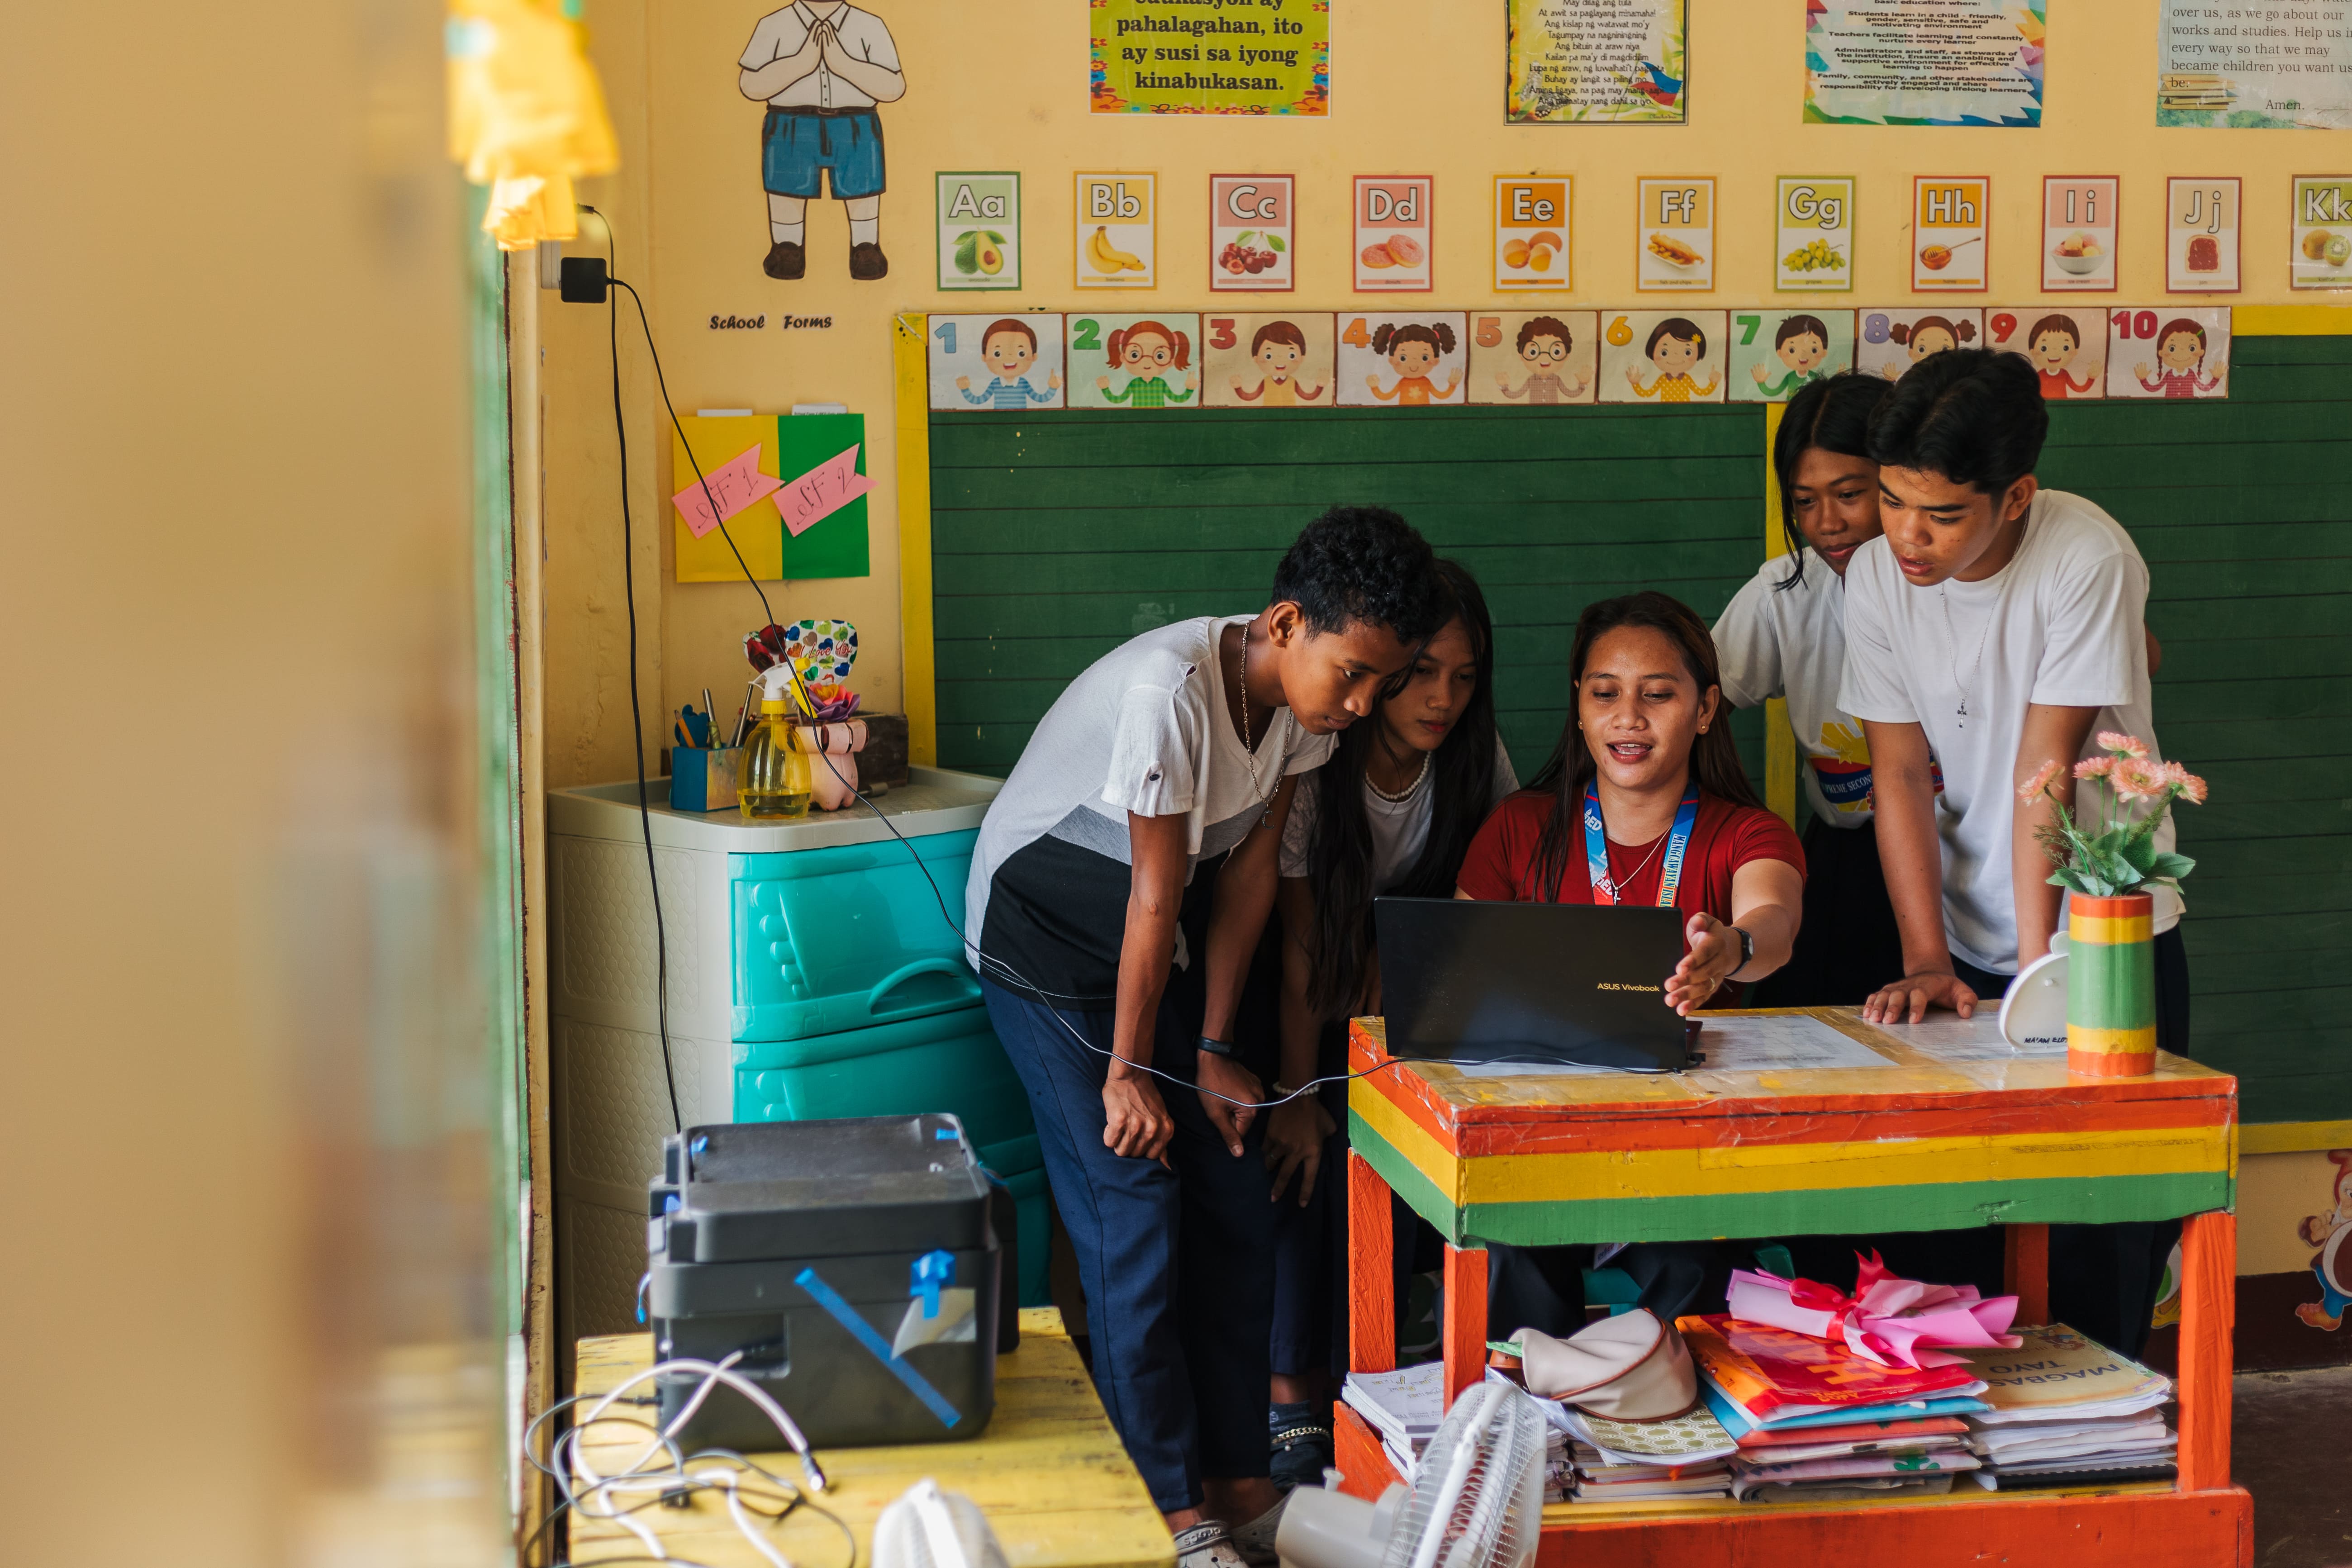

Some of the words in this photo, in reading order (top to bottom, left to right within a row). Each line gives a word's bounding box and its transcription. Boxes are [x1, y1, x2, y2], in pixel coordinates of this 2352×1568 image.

[1117, 15, 1265, 37] pahalagahan,
[1273, 18, 1303, 34] ito
[1544, 19, 1560, 29] Ang
[1563, 20, 1583, 30] kislap
[1586, 21, 1595, 29] ng
[1631, 19, 1649, 30] mo'y
[1579, 9, 1616, 19] paglayang
[2173, 9, 2200, 17] over
[2203, 10, 2222, 19] us,
[2266, 11, 2279, 21] go
[2284, 9, 2319, 19] about
[1547, 30, 1585, 41] Tagumpay
[1598, 31, 1647, 41] nagniningning
[2172, 25, 2209, 35] works
[2214, 25, 2237, 35] and
[2242, 26, 2289, 36] studies.
[2295, 27, 2322, 39] Help
[1122, 48, 1148, 65] ay
[1155, 44, 1200, 61] susi
[1207, 49, 1231, 61] sa
[1239, 44, 1298, 67] iyong
[1555, 42, 1570, 52] Ang
[1625, 43, 1639, 52] niya
[1580, 52, 1598, 63] ma'y
[2172, 45, 2205, 55] every
[2208, 45, 2233, 56] way
[2255, 43, 2280, 54] that
[2304, 47, 2330, 57] may
[1135, 71, 1283, 90] kinabukasan.
[1544, 74, 1567, 84] Buhay
[2171, 59, 2219, 70] became
[2224, 60, 2273, 71] children
[2278, 64, 2300, 74] you
[2304, 63, 2334, 72] want
[2171, 77, 2189, 87] be.
[2266, 100, 2304, 110] Amen.
[948, 184, 1005, 218] Aa
[1090, 183, 1141, 218] Bb
[1228, 185, 1277, 219] Cc
[1368, 187, 1418, 222] Dd
[1512, 188, 1555, 222] Ee
[1660, 188, 1696, 224] Ff
[1788, 186, 1842, 230] Gg
[1927, 189, 1975, 223] Hh
[2305, 188, 2352, 222] Kk
[709, 315, 765, 329] School
[784, 315, 832, 329] Forms
[1073, 319, 1101, 350] 2
[1209, 319, 1236, 350] 3
[1342, 318, 1371, 348] 4
[1475, 317, 1503, 347] 5
[1606, 316, 1634, 346] 6
[1736, 315, 1761, 345] 7
[1864, 313, 1890, 343] 8
[1991, 313, 2017, 343] 9
[2111, 310, 2158, 340] 10
[934, 323, 956, 353] 1
[837, 467, 856, 494] 2
[809, 642, 831, 659] Love
[836, 639, 853, 656] You
[1663, 833, 1687, 888] MANGCAWAYAN
[1987, 1364, 2121, 1387] MAGBAS
[1990, 1360, 2066, 1374] TAYO
